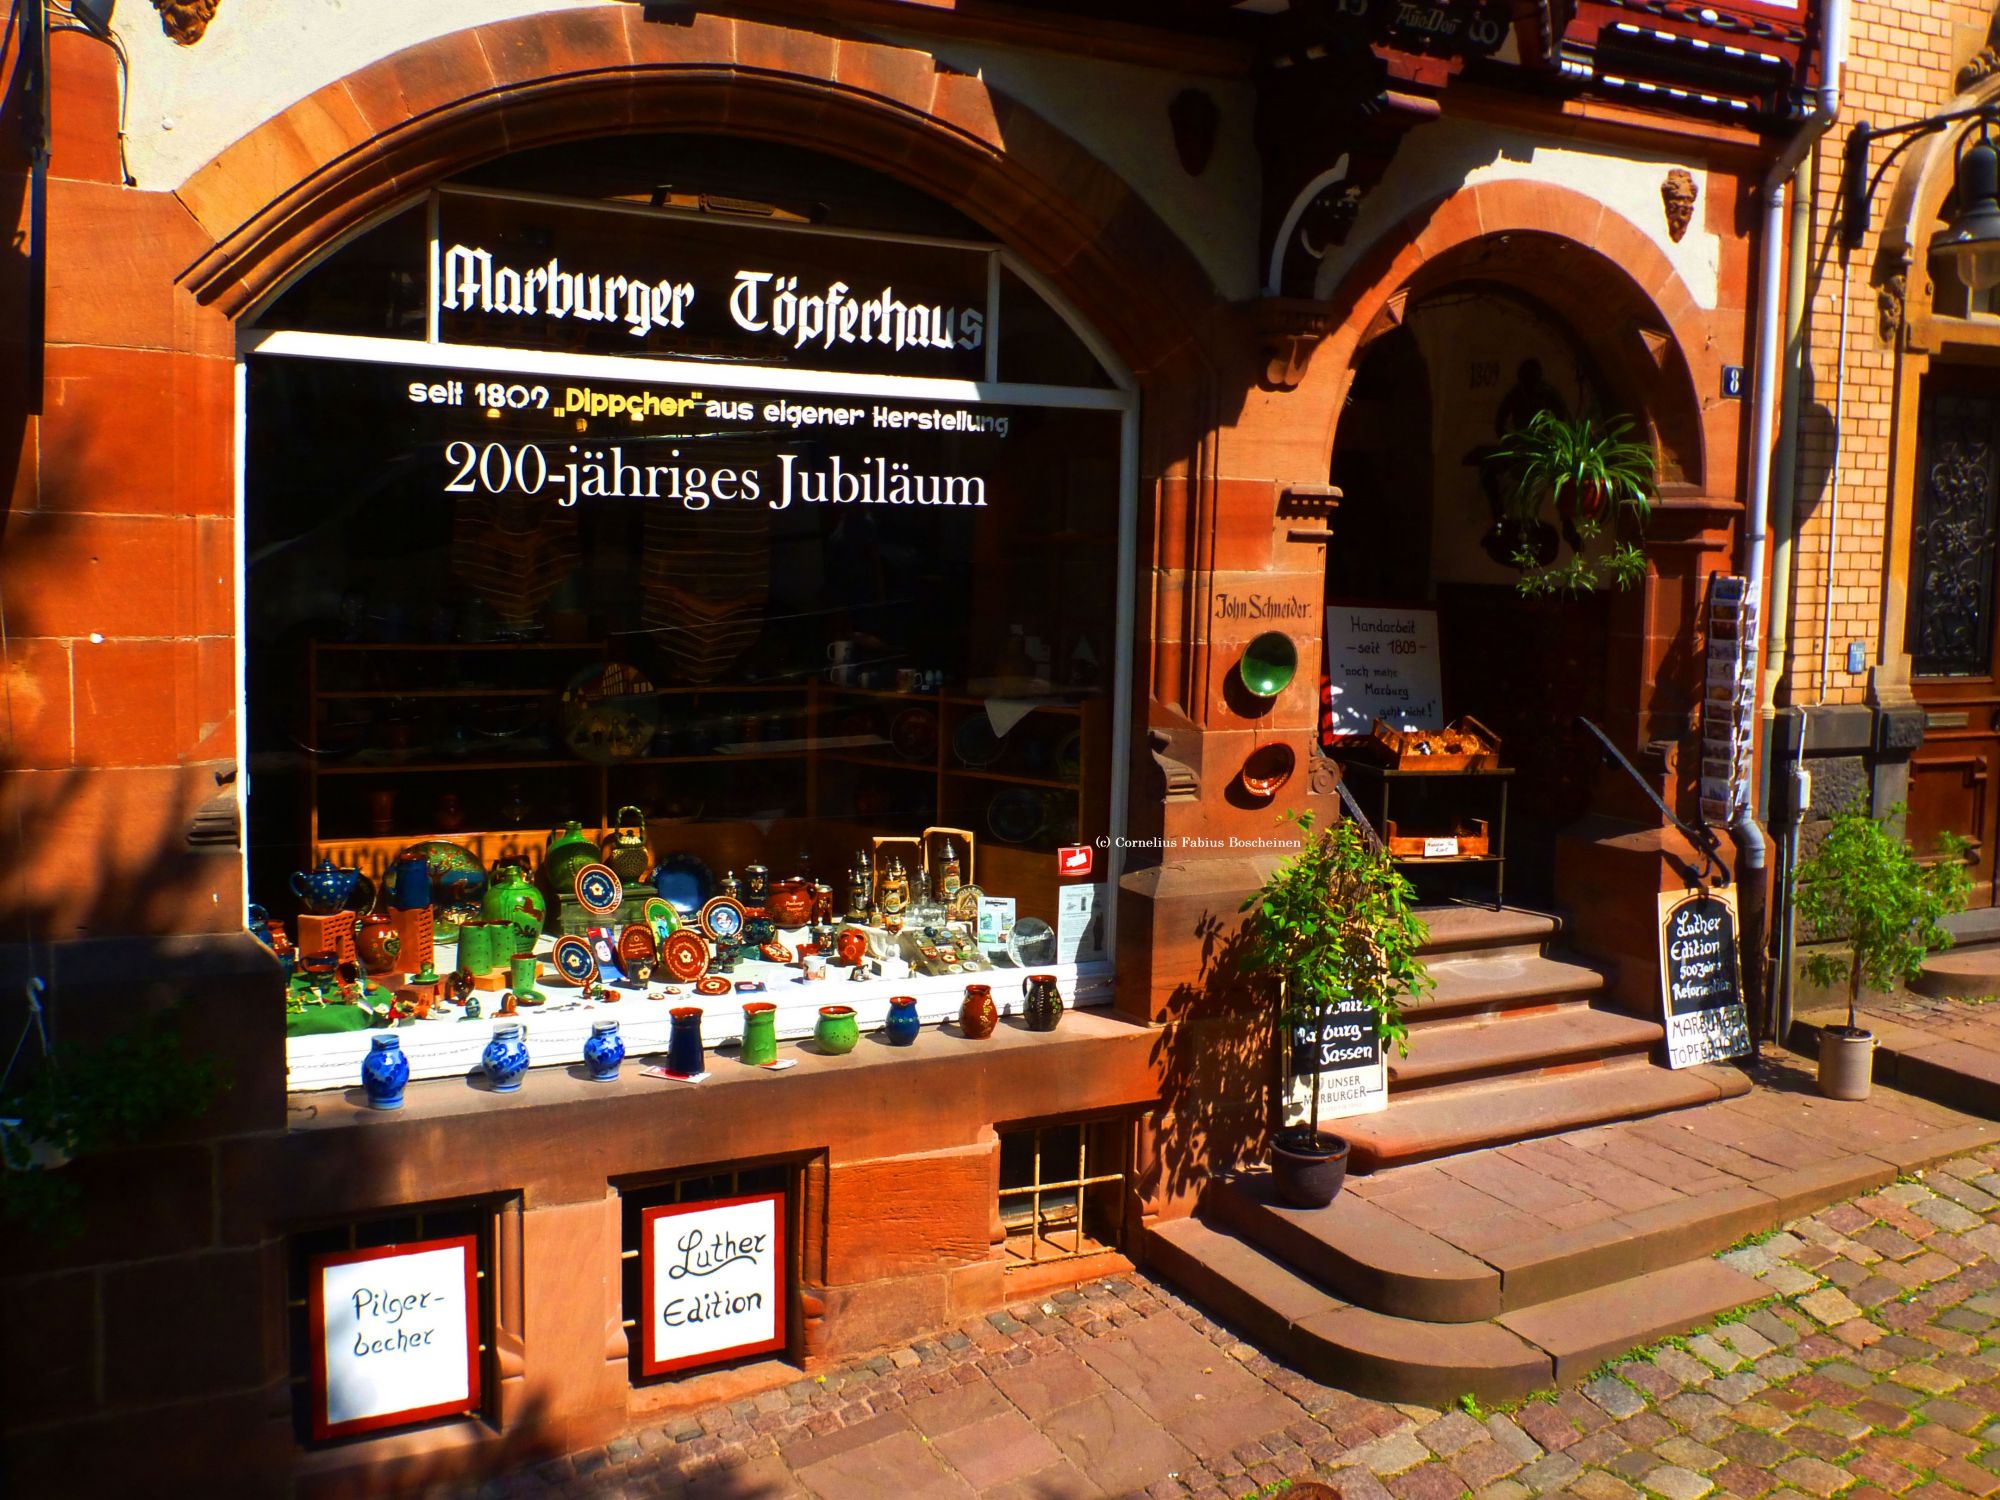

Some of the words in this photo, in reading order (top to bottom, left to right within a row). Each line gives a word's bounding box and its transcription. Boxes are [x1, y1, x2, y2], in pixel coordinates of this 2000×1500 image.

[443, 244, 695, 337] Marburger
[729, 270, 985, 352] Töpferhaus
[1729, 369, 1740, 393] 8
[408, 381, 463, 406] seit
[475, 383, 550, 410] 1809
[705, 401, 754, 421] aus
[764, 401, 865, 426] eigener
[873, 406, 1009, 438] Herstellung
[444, 440, 761, 510] 200-jähriges
[769, 454, 989, 510] Jubiläum
[1215, 593, 1247, 620] John
[1351, 616, 1416, 634] Handarbeit
[1364, 684, 1410, 700] Marburg
[1676, 910, 1721, 937] Luther
[1670, 939, 1720, 961] Edition
[1320, 1042, 1373, 1065] Tassen
[1303, 1086, 1367, 1106] MRBURGER
[1328, 1075, 1361, 1090] UNSER
[669, 1228, 766, 1279] Luther
[352, 1287, 445, 1323] Pilger-
[663, 1291, 762, 1327] Edition
[353, 1327, 434, 1357] becher
